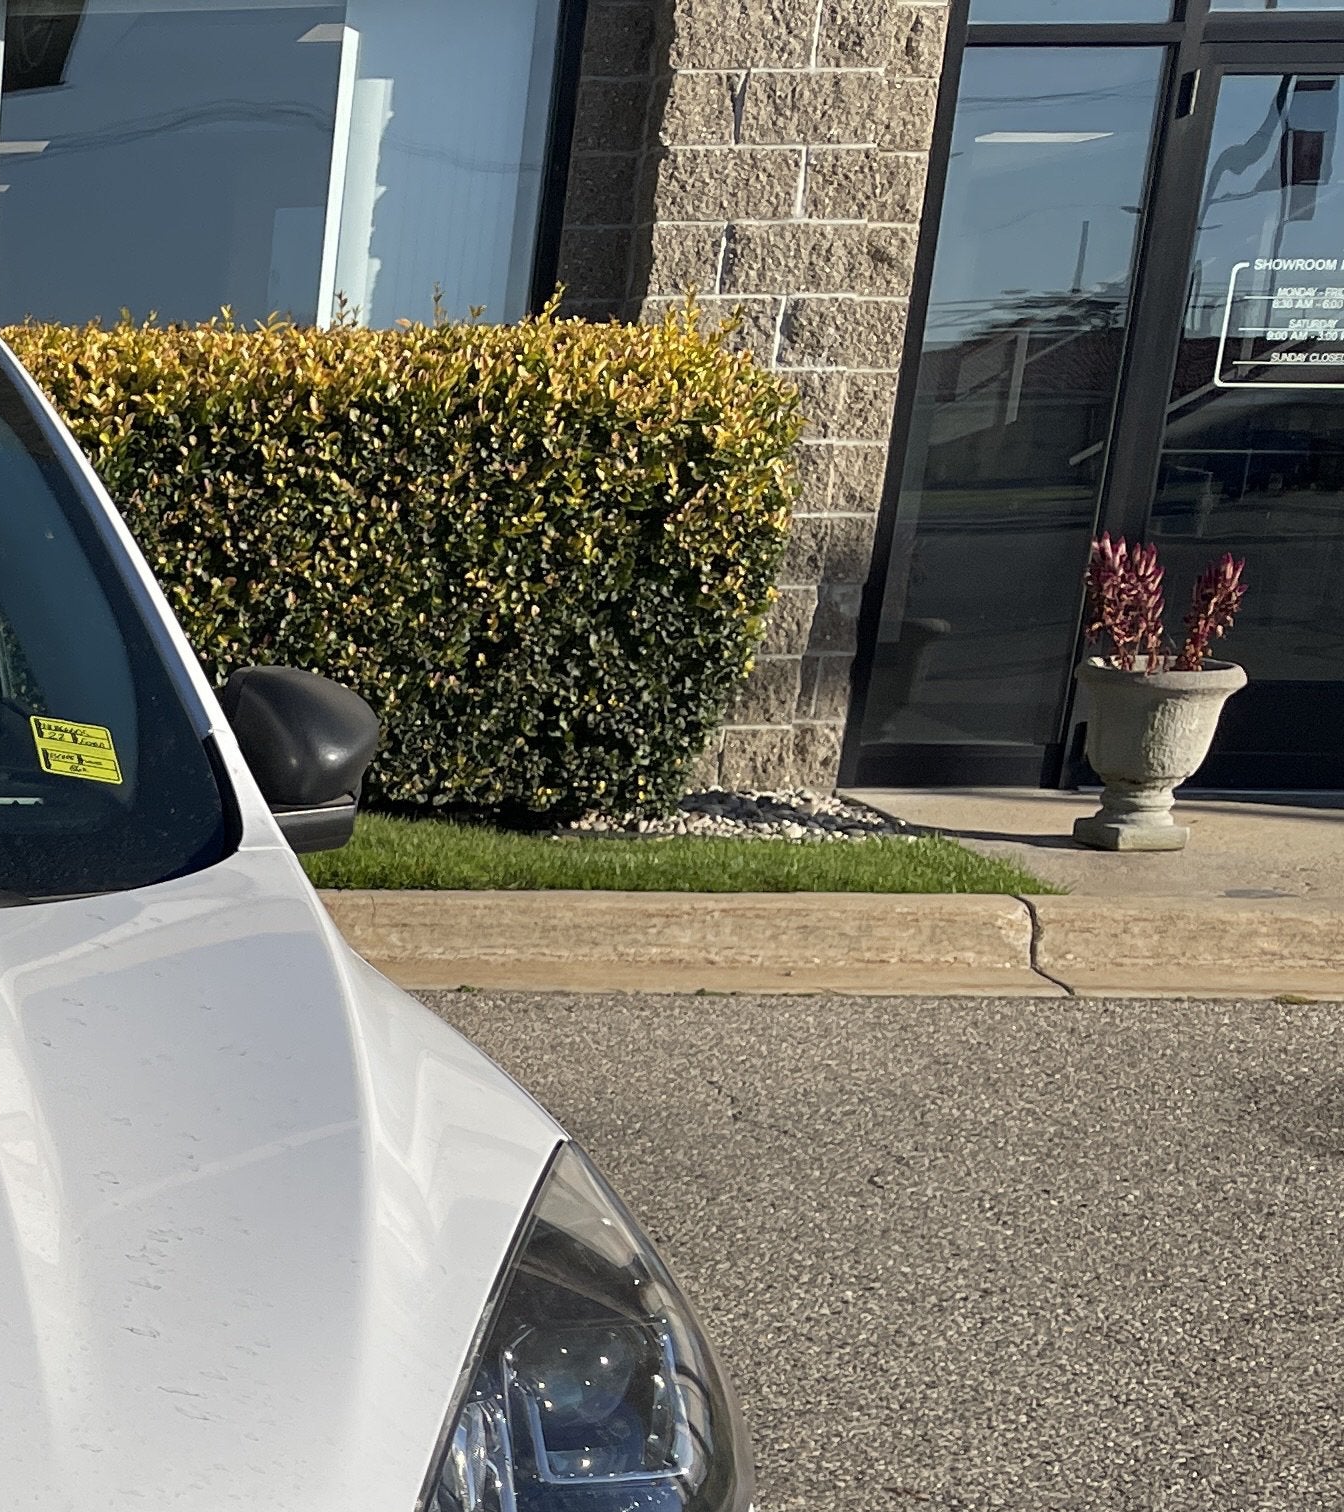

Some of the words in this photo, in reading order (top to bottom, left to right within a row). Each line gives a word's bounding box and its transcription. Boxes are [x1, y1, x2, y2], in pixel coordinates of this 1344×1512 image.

[1254, 258, 1338, 271] SHOWROOM
[1295, 299, 1314, 309] AM
[1288, 318, 1339, 329] SATURDAY
[1290, 330, 1308, 341] AM
[1270, 352, 1310, 363] SUNDAY
